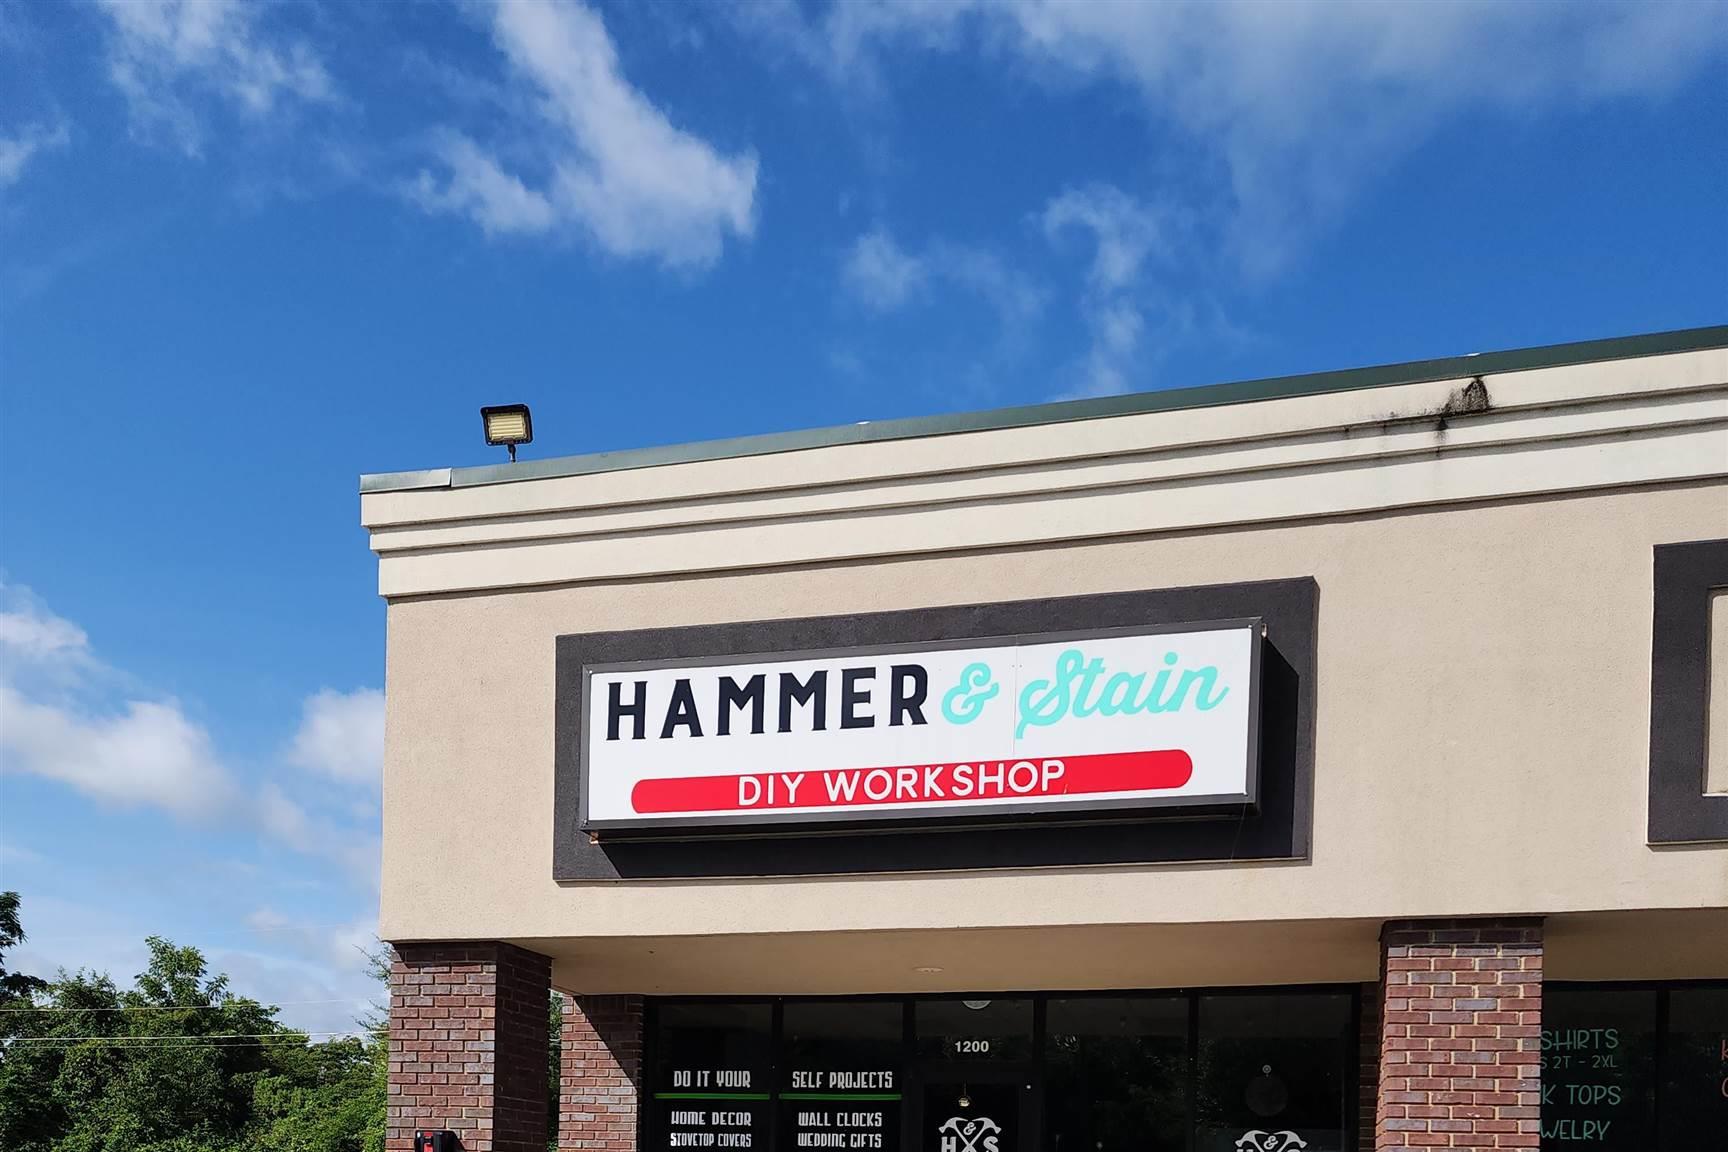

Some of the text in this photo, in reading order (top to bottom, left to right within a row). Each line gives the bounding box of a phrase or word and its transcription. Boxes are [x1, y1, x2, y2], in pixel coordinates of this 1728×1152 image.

[606, 649, 1229, 741] HAMMER & Stain
[738, 759, 1066, 807] DIY WORKSHOP
[955, 1040, 989, 1053] 1200
[1553, 1056, 1571, 1069] 2T
[1592, 1055, 1618, 1068] 2XL
[674, 1070, 751, 1088] DO IT YOUR
[792, 1071, 893, 1089] SELF PROJECTS
[1565, 1085, 1622, 1105] TOPS
[671, 1111, 752, 1127] HOME DECOR
[798, 1112, 882, 1127] WALL CLOCKS
[963, 1122, 976, 1136] &
[1540, 1119, 1611, 1140] WELRY
[670, 1133, 752, 1148] STOVETOP COVERS
[797, 1133, 882, 1148] WEDDING GIFTS
[1263, 1135, 1279, 1150] &
